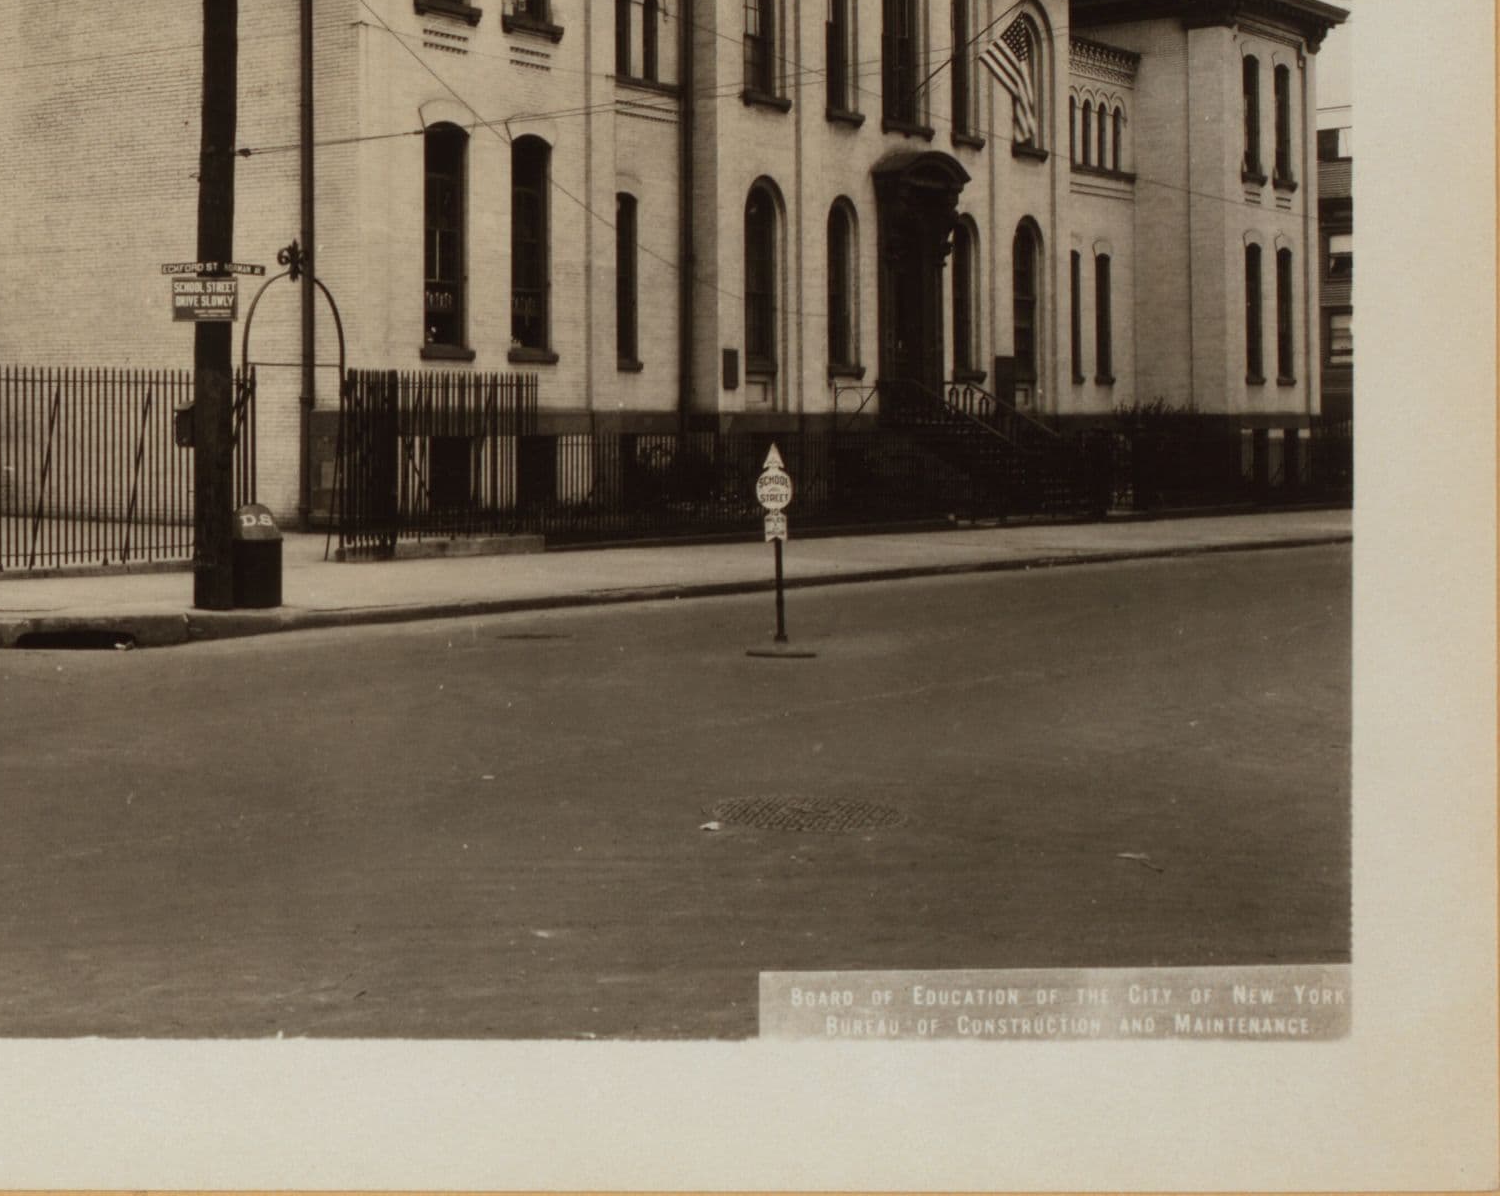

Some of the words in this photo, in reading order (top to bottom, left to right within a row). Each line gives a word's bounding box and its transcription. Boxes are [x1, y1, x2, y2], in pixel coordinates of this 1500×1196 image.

[206, 262, 217, 272] ST
[174, 281, 205, 293] SCHOOL
[206, 281, 236, 293] STREET
[175, 295, 199, 307] DRIVE
[201, 295, 234, 307] SLOWLY
[758, 475, 789, 488] SCHOOL
[760, 493, 789, 503] STREET
